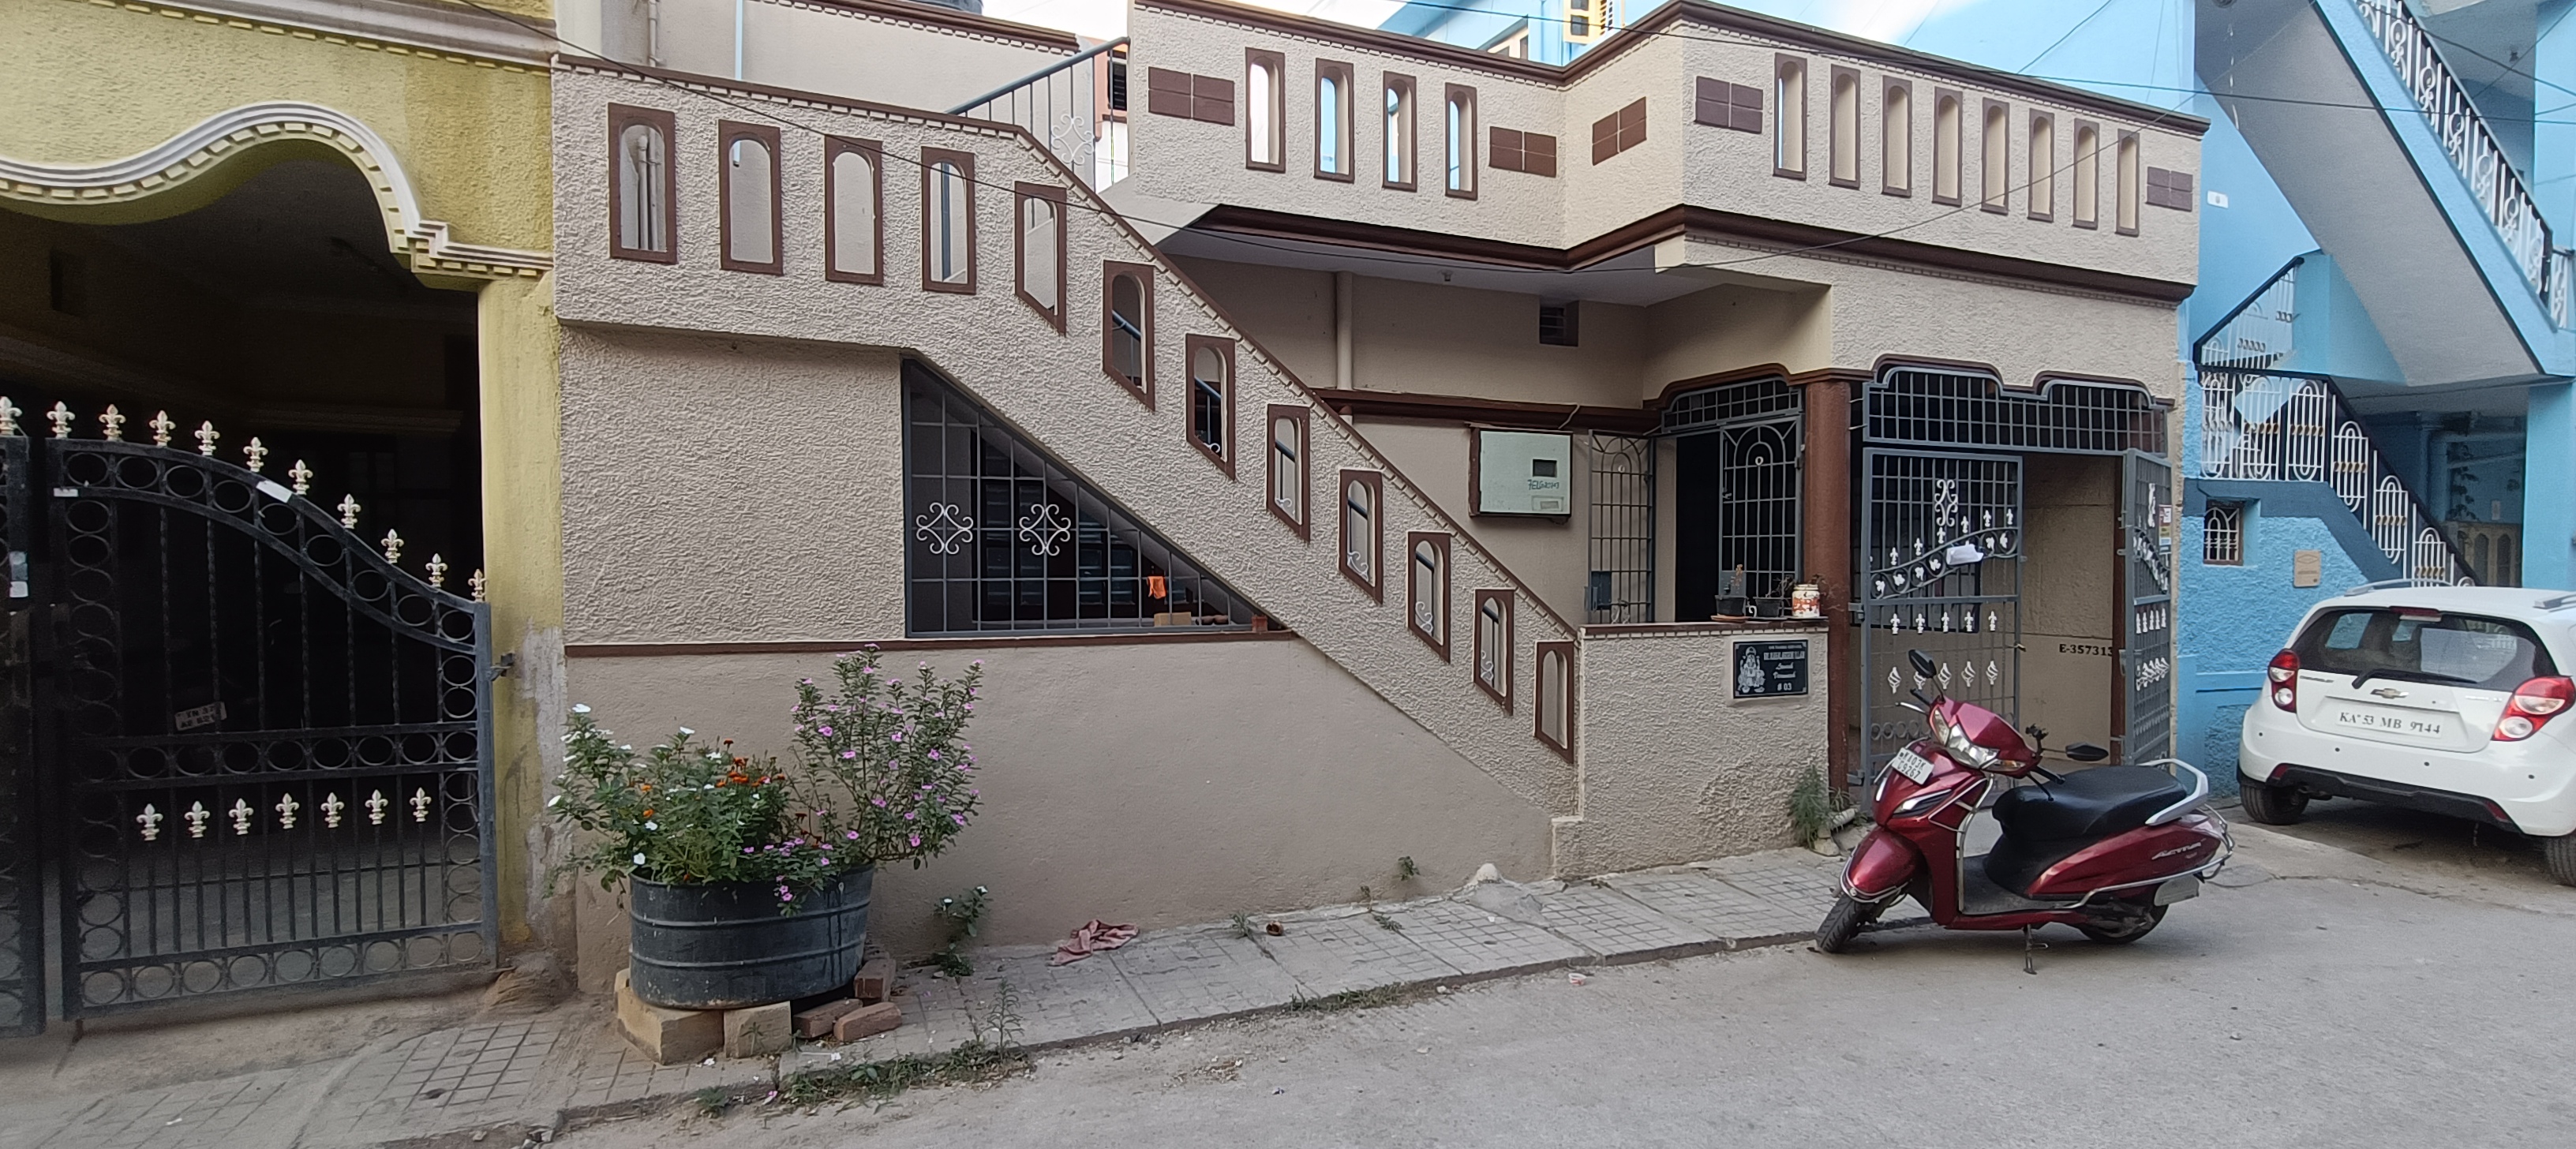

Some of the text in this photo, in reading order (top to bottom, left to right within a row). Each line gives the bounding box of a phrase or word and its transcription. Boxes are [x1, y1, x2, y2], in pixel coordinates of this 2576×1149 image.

[1784, 682, 1792, 691] 03
[2339, 712, 2357, 724] KA
[2362, 715, 2374, 725] 53
[2379, 717, 2402, 729] MB
[1903, 751, 1926, 770] KA03K
